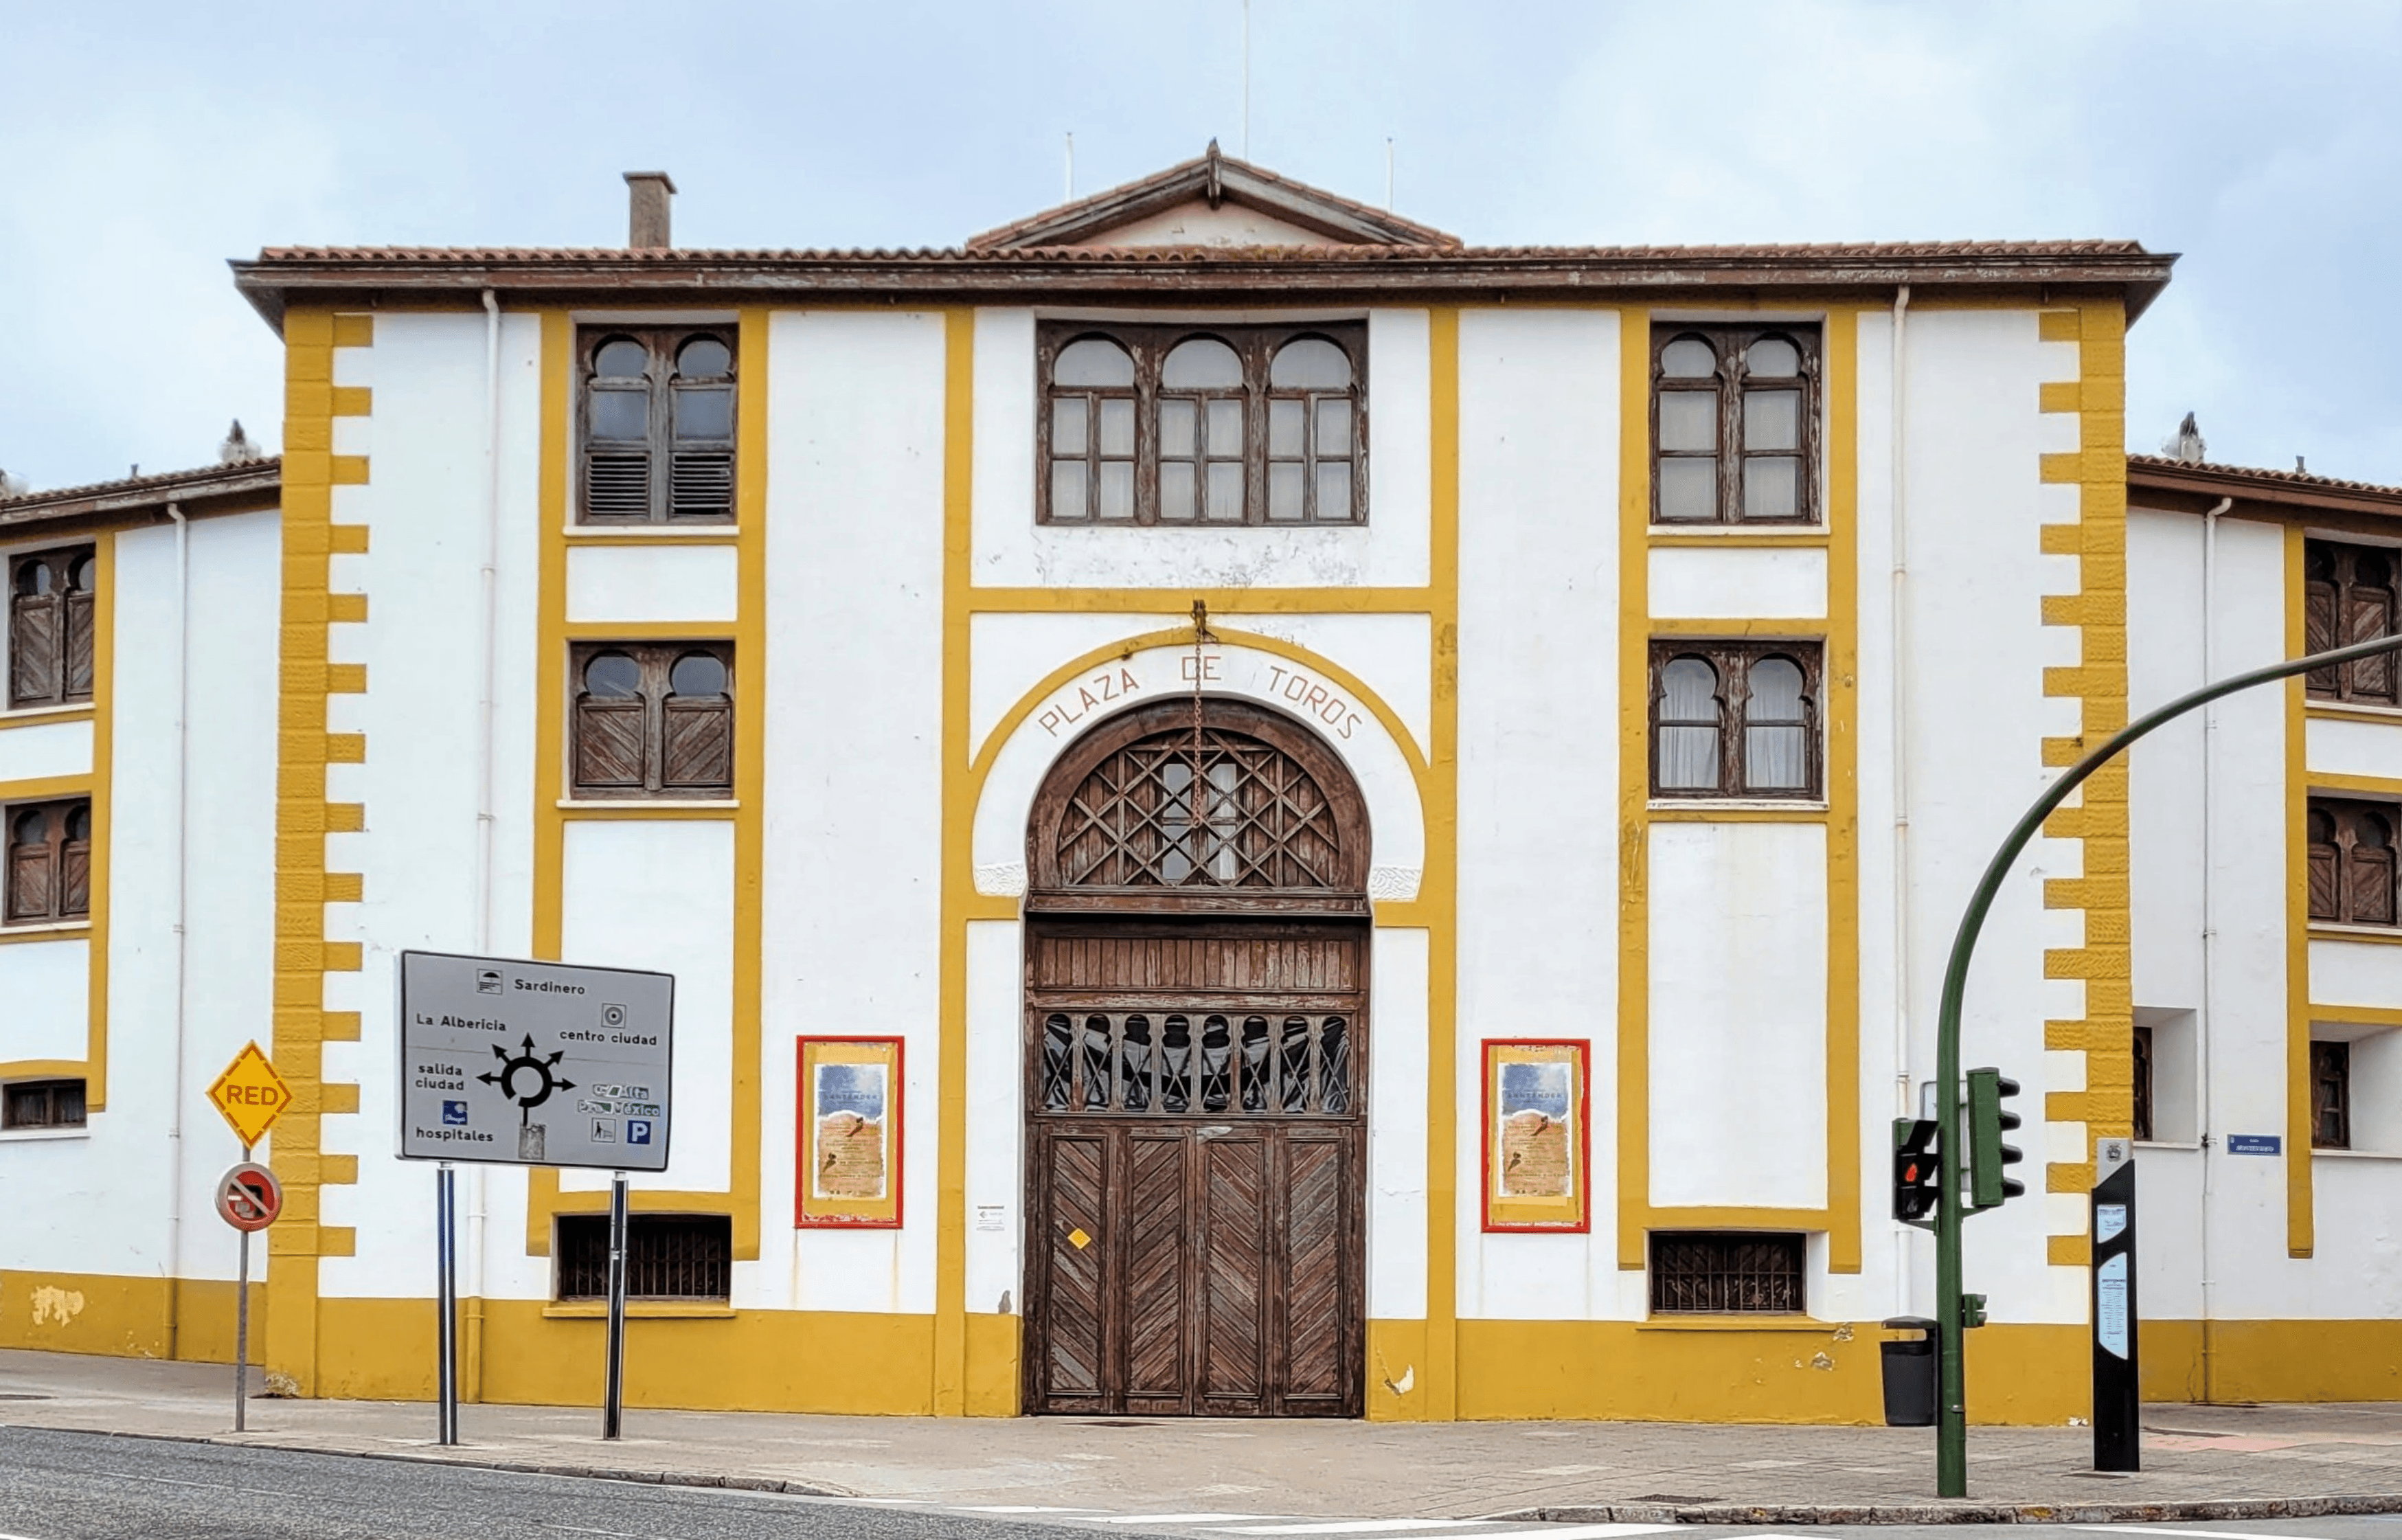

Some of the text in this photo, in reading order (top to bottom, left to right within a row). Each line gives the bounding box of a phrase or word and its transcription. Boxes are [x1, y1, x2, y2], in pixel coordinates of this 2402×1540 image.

[1038, 655, 1363, 740] PLAZA DE TOROS
[514, 979, 585, 995] Sardinero
[416, 1013, 507, 1031] La Albericia
[560, 1030, 657, 1045] centro ciudad
[418, 1063, 462, 1076] salida
[416, 1077, 464, 1090] ciudad
[226, 1084, 279, 1106] RED
[416, 1126, 494, 1142] hospitales
[632, 1122, 648, 1142] P
